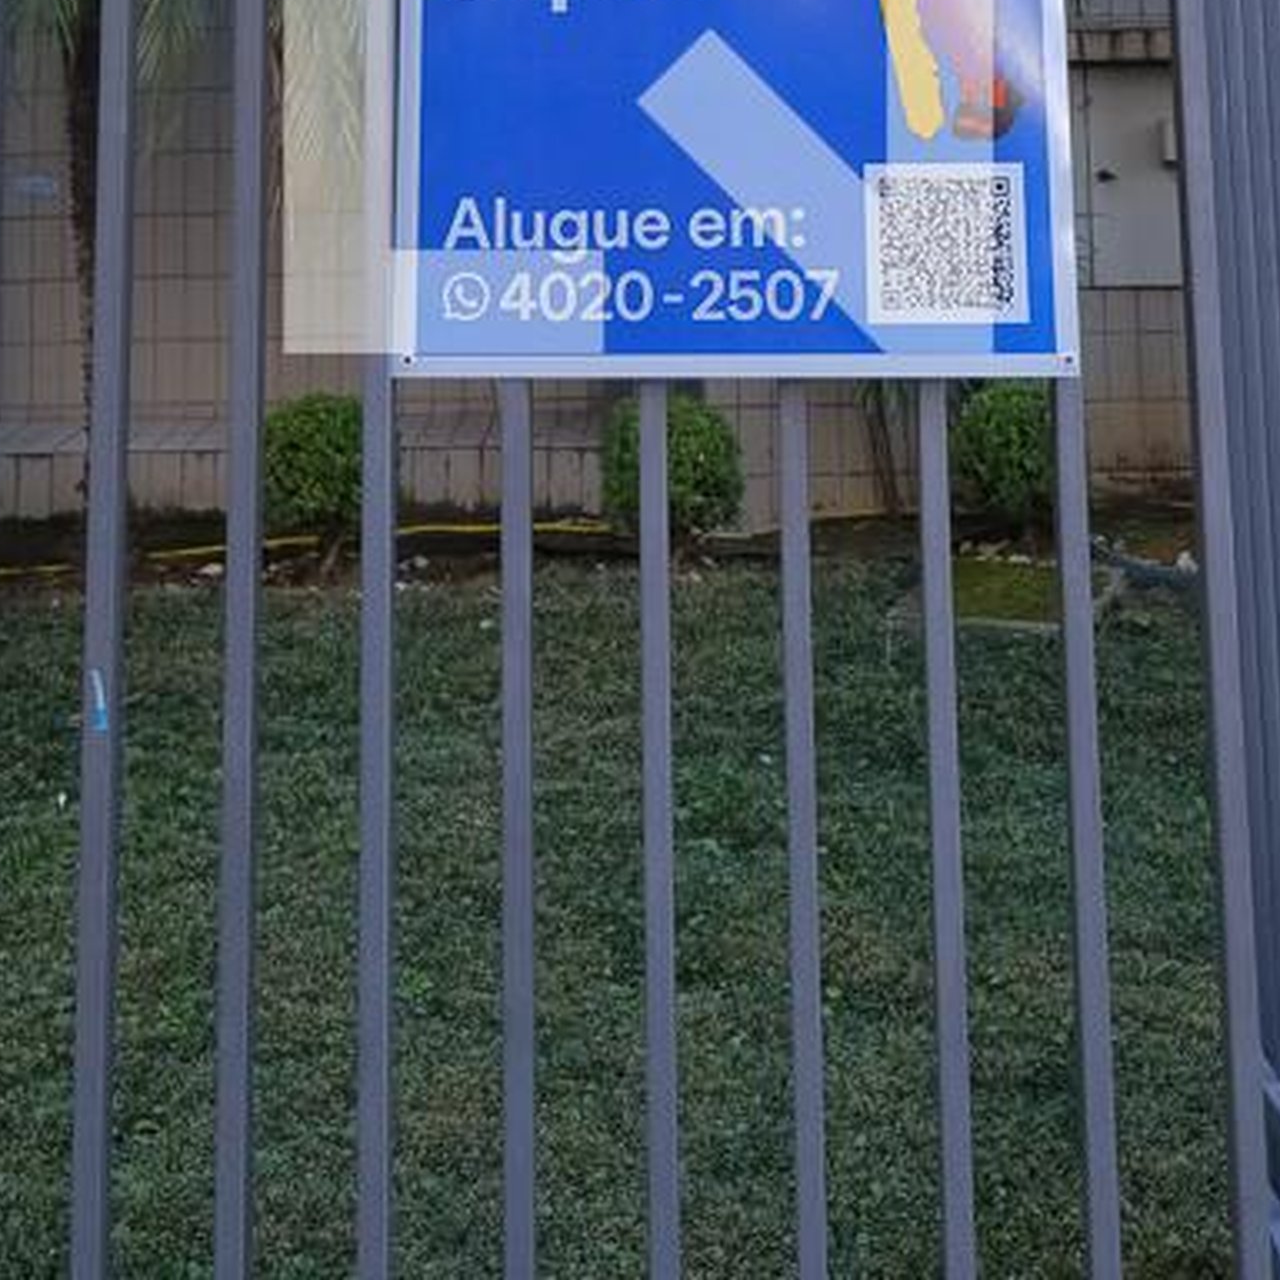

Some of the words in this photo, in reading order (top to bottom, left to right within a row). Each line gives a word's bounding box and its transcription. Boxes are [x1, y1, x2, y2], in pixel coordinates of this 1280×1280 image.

[442, 196, 670, 266] Alugue
[689, 204, 806, 250] em:
[499, 269, 840, 322] 4020-2507
